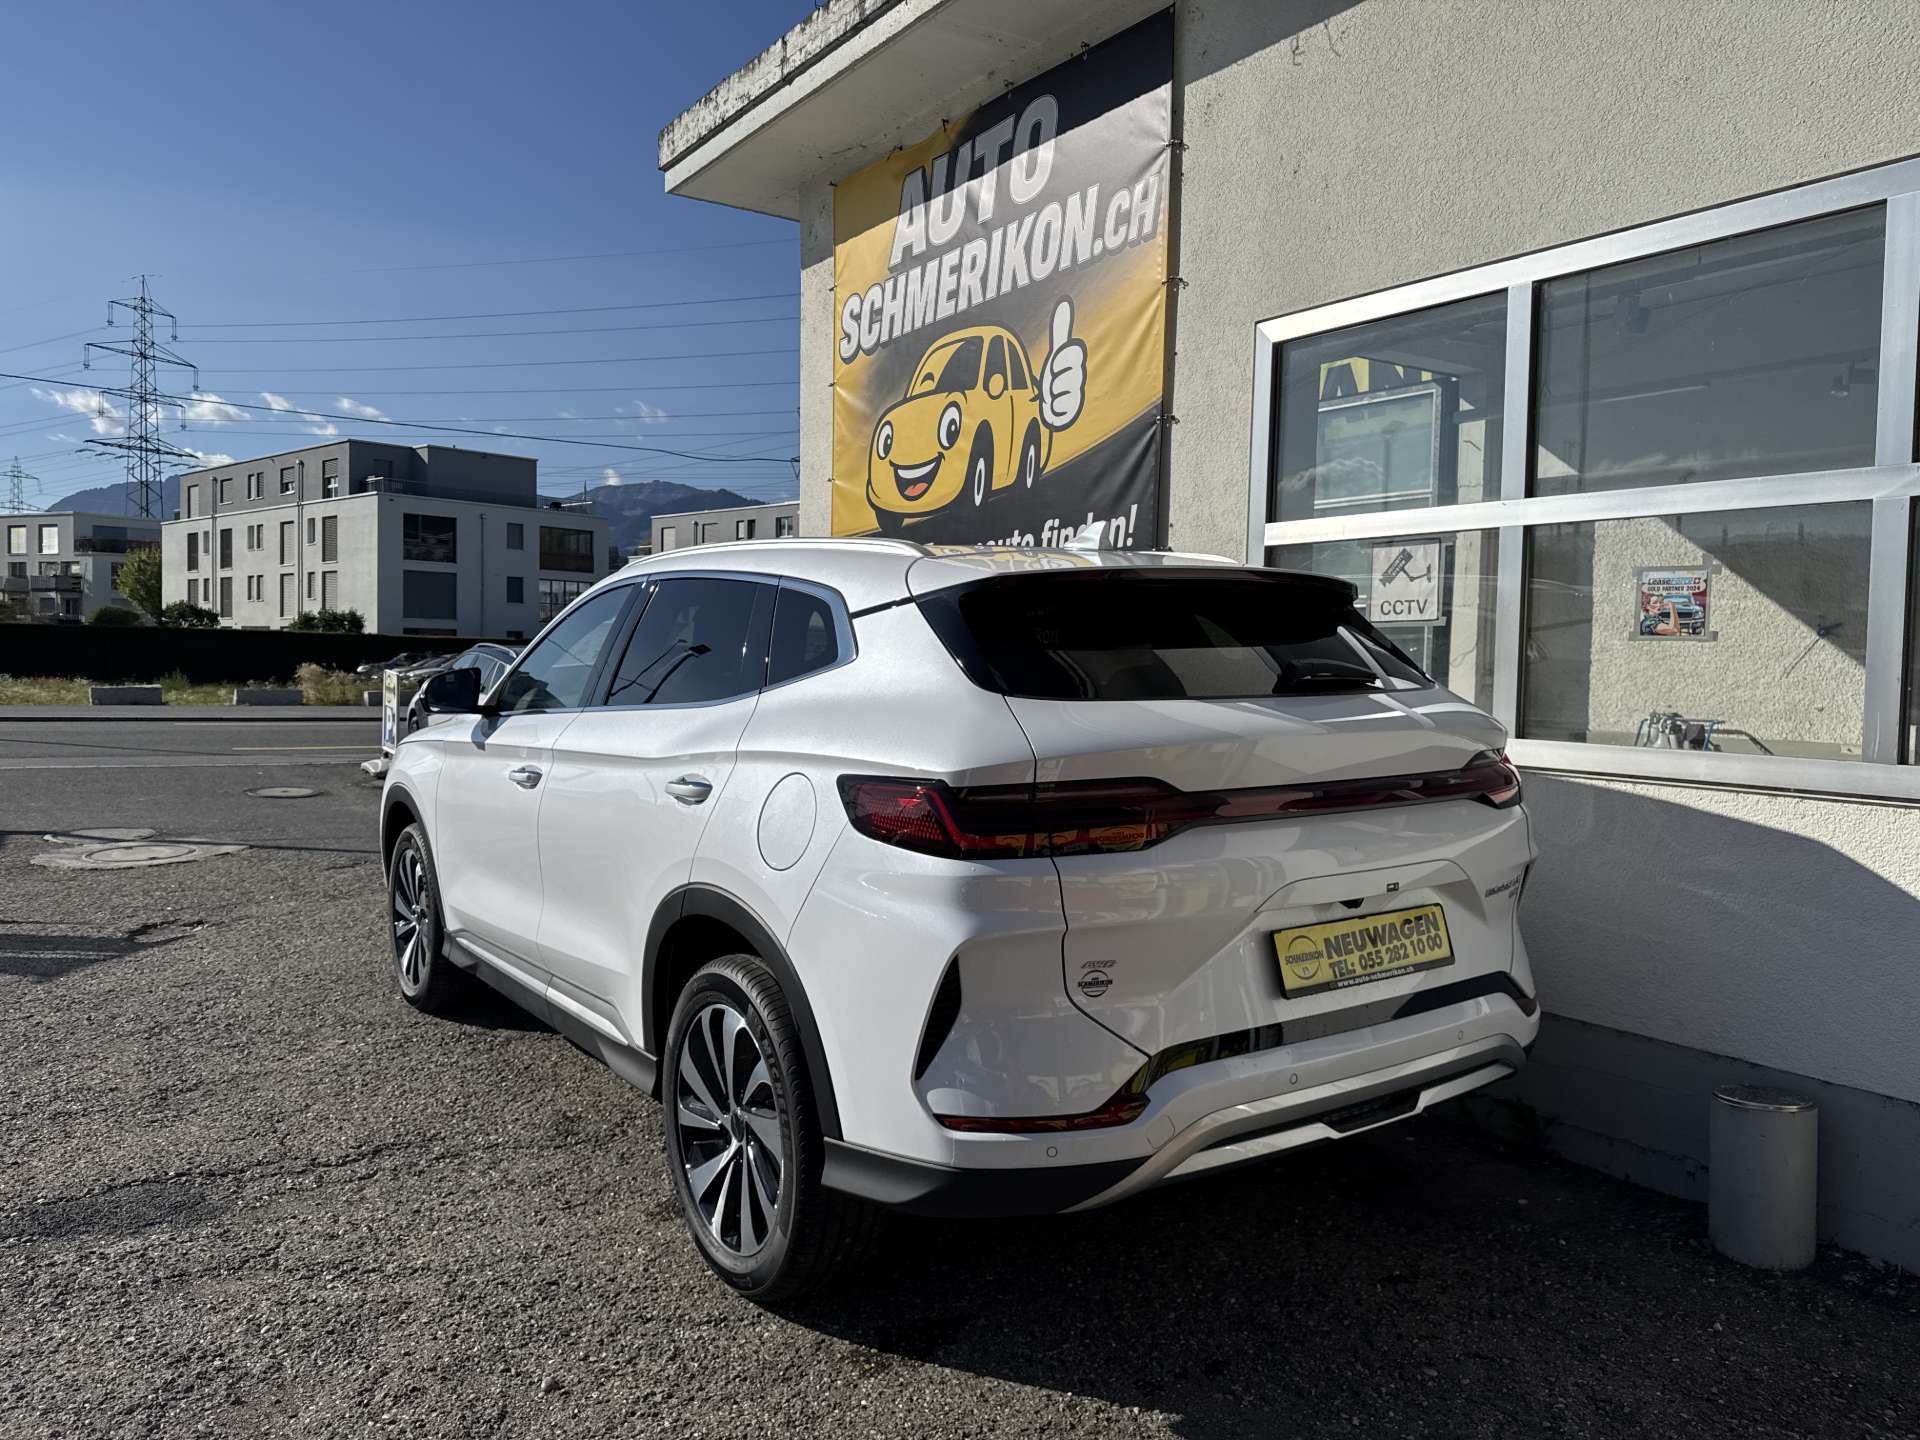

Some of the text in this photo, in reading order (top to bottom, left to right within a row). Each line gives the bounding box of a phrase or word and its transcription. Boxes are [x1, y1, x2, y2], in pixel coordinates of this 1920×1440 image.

[889, 93, 1059, 268] AUTO
[838, 171, 1161, 362] SCHMERIKON.CH
[1380, 598, 1429, 616] CCTV
[1323, 911, 1440, 960] NEUWAGEN
[1328, 932, 1443, 979] TEL: 055 282 10 00
